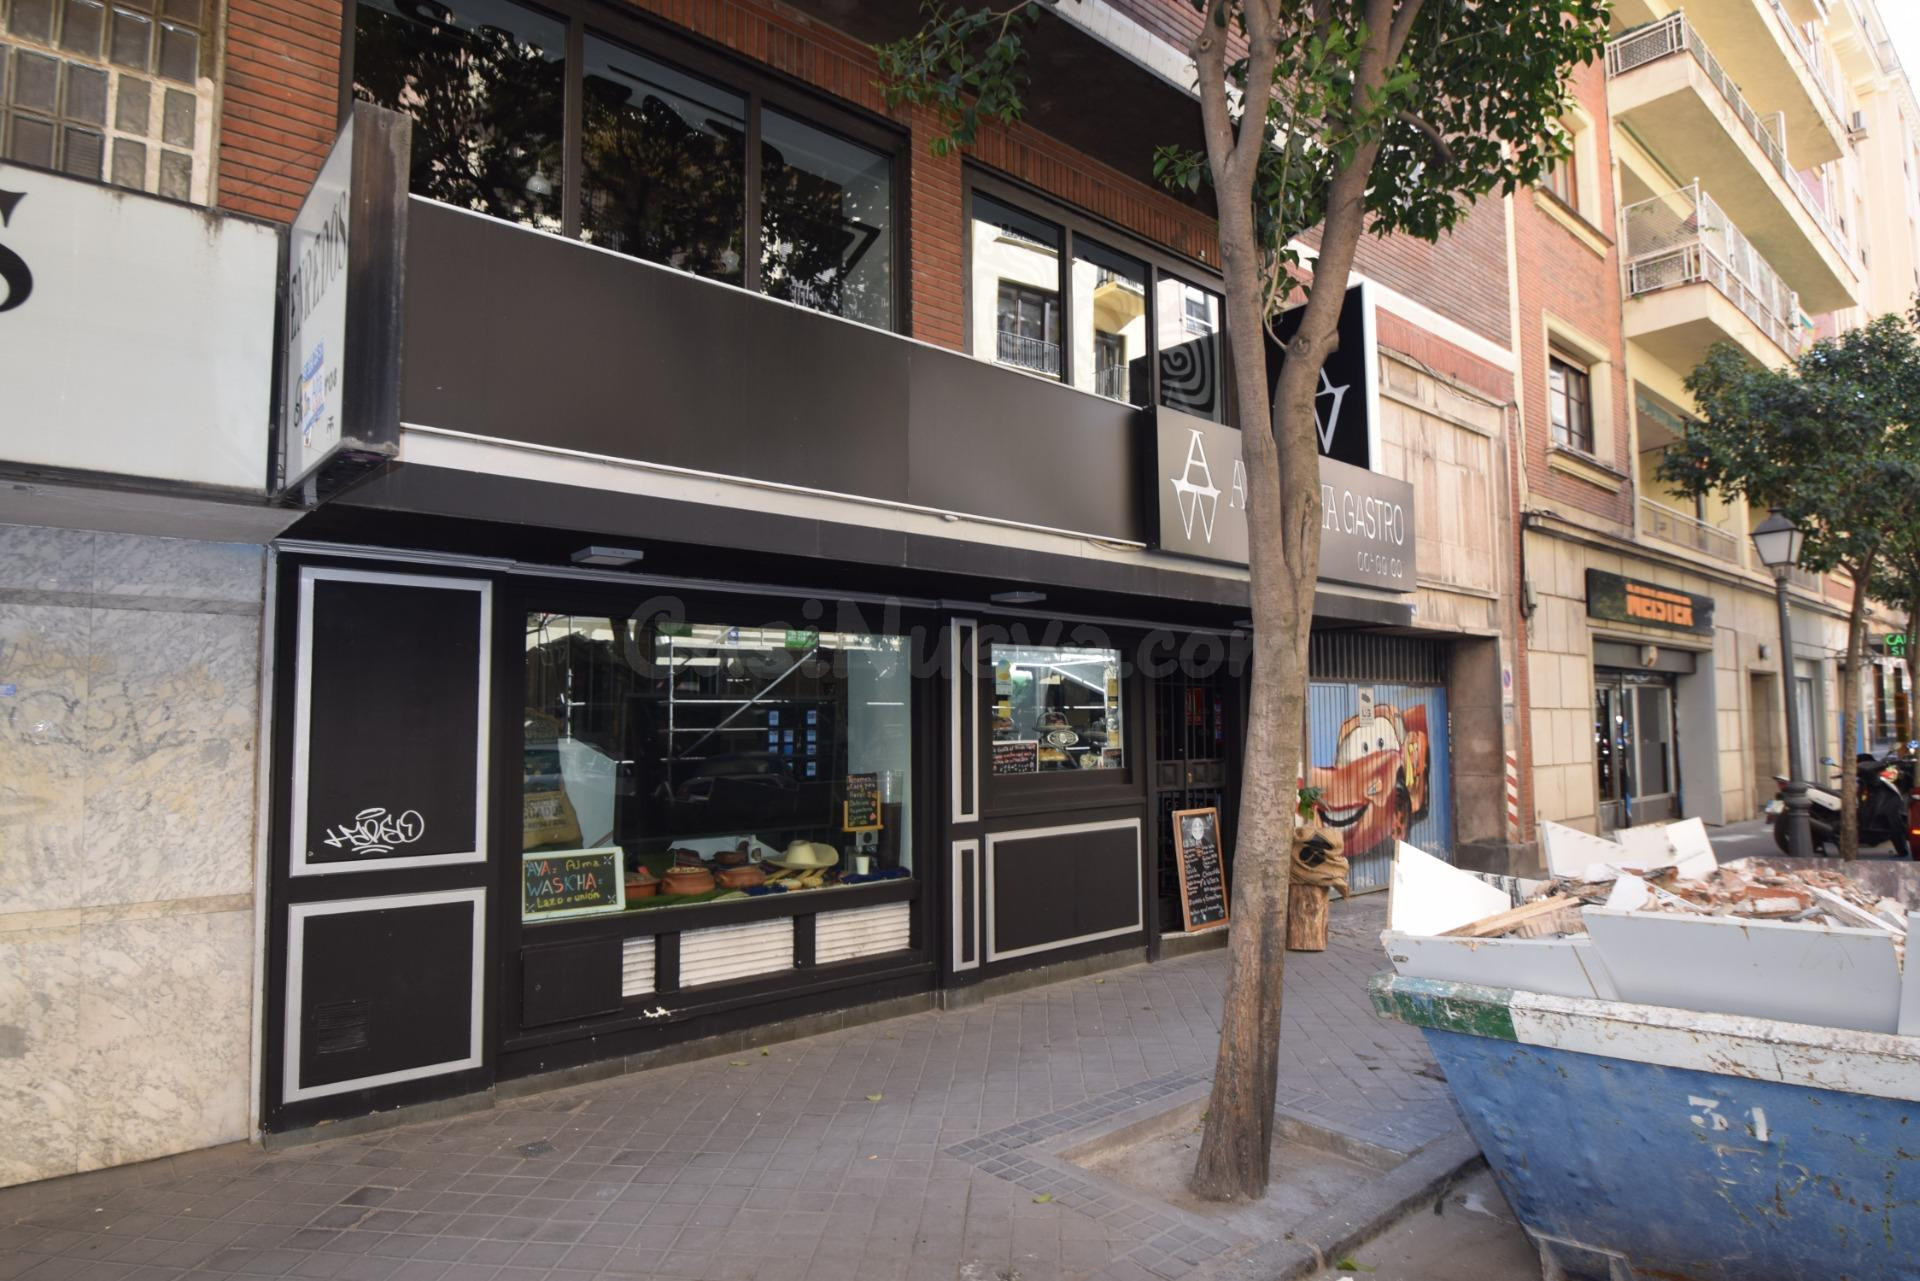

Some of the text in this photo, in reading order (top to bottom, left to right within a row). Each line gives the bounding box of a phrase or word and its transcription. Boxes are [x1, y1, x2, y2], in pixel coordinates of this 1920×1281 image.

[291, 191, 346, 341] ENREDOS
[1343, 490, 1403, 546] GASTRO
[565, 859, 600, 872] Alma
